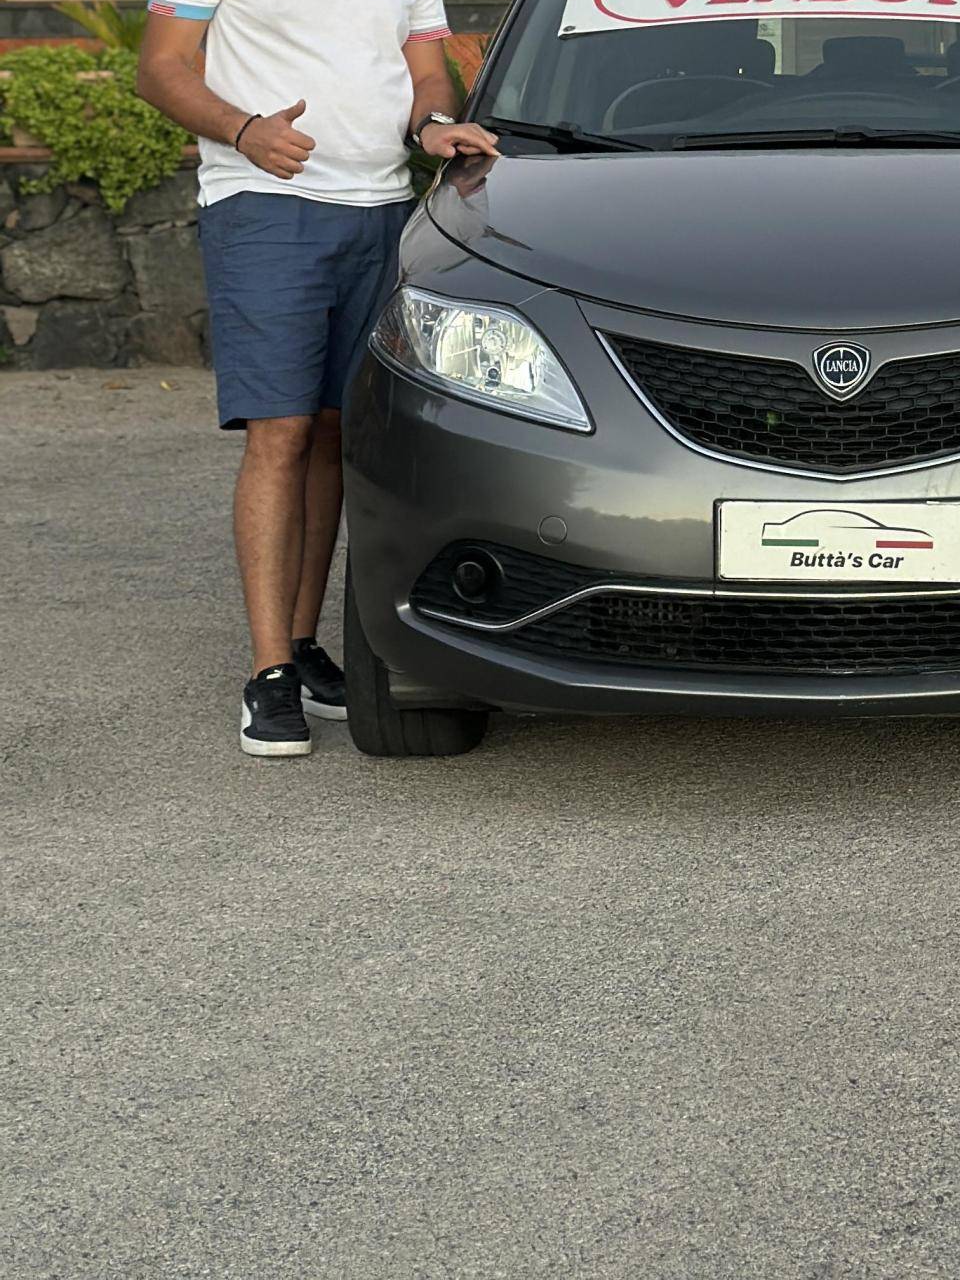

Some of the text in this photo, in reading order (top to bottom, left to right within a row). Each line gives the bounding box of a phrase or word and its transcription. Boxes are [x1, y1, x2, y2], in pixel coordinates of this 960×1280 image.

[826, 360, 858, 372] LANCIA
[790, 551, 904, 569] Buttà's Car
